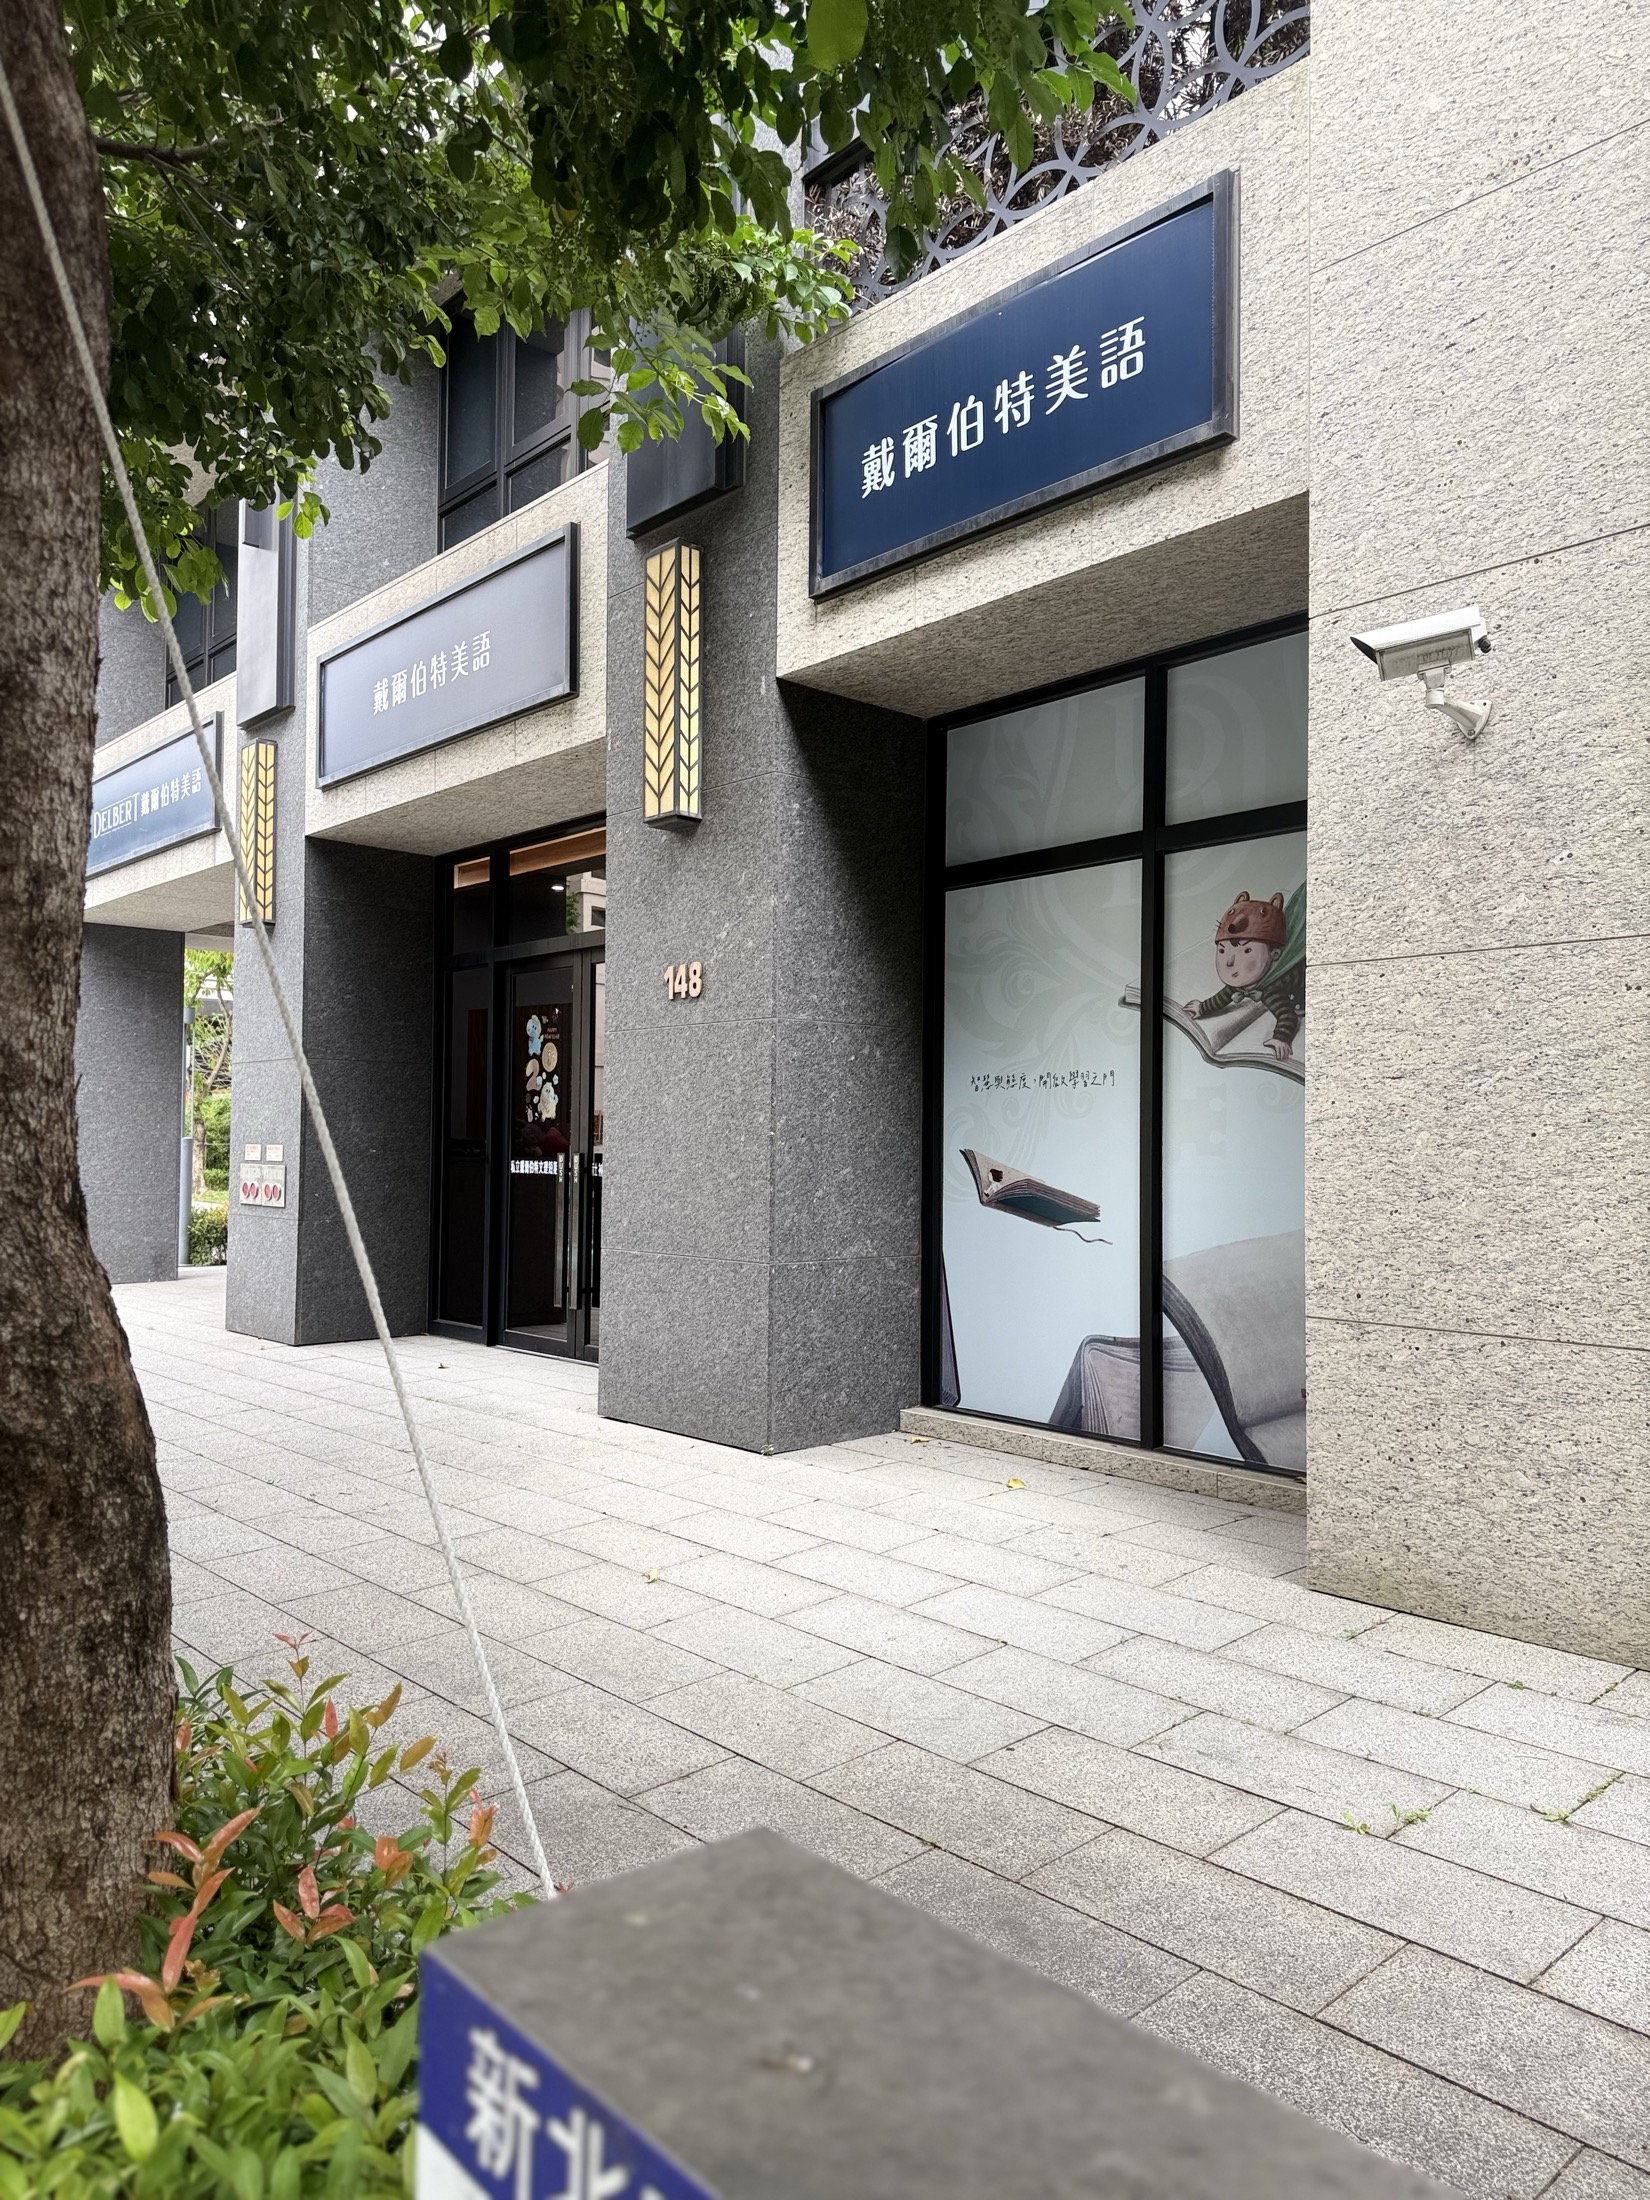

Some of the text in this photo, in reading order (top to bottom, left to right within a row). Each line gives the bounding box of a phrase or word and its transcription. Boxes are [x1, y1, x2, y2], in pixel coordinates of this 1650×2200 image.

[862, 315, 1146, 499] 戴爾伯特美語
[372, 630, 491, 716] 戴爾伯特美語
[93, 767, 202, 838] DELBERT 戴爾伯特美語
[663, 961, 702, 1000] 148
[466, 2026, 664, 2200] 新北
